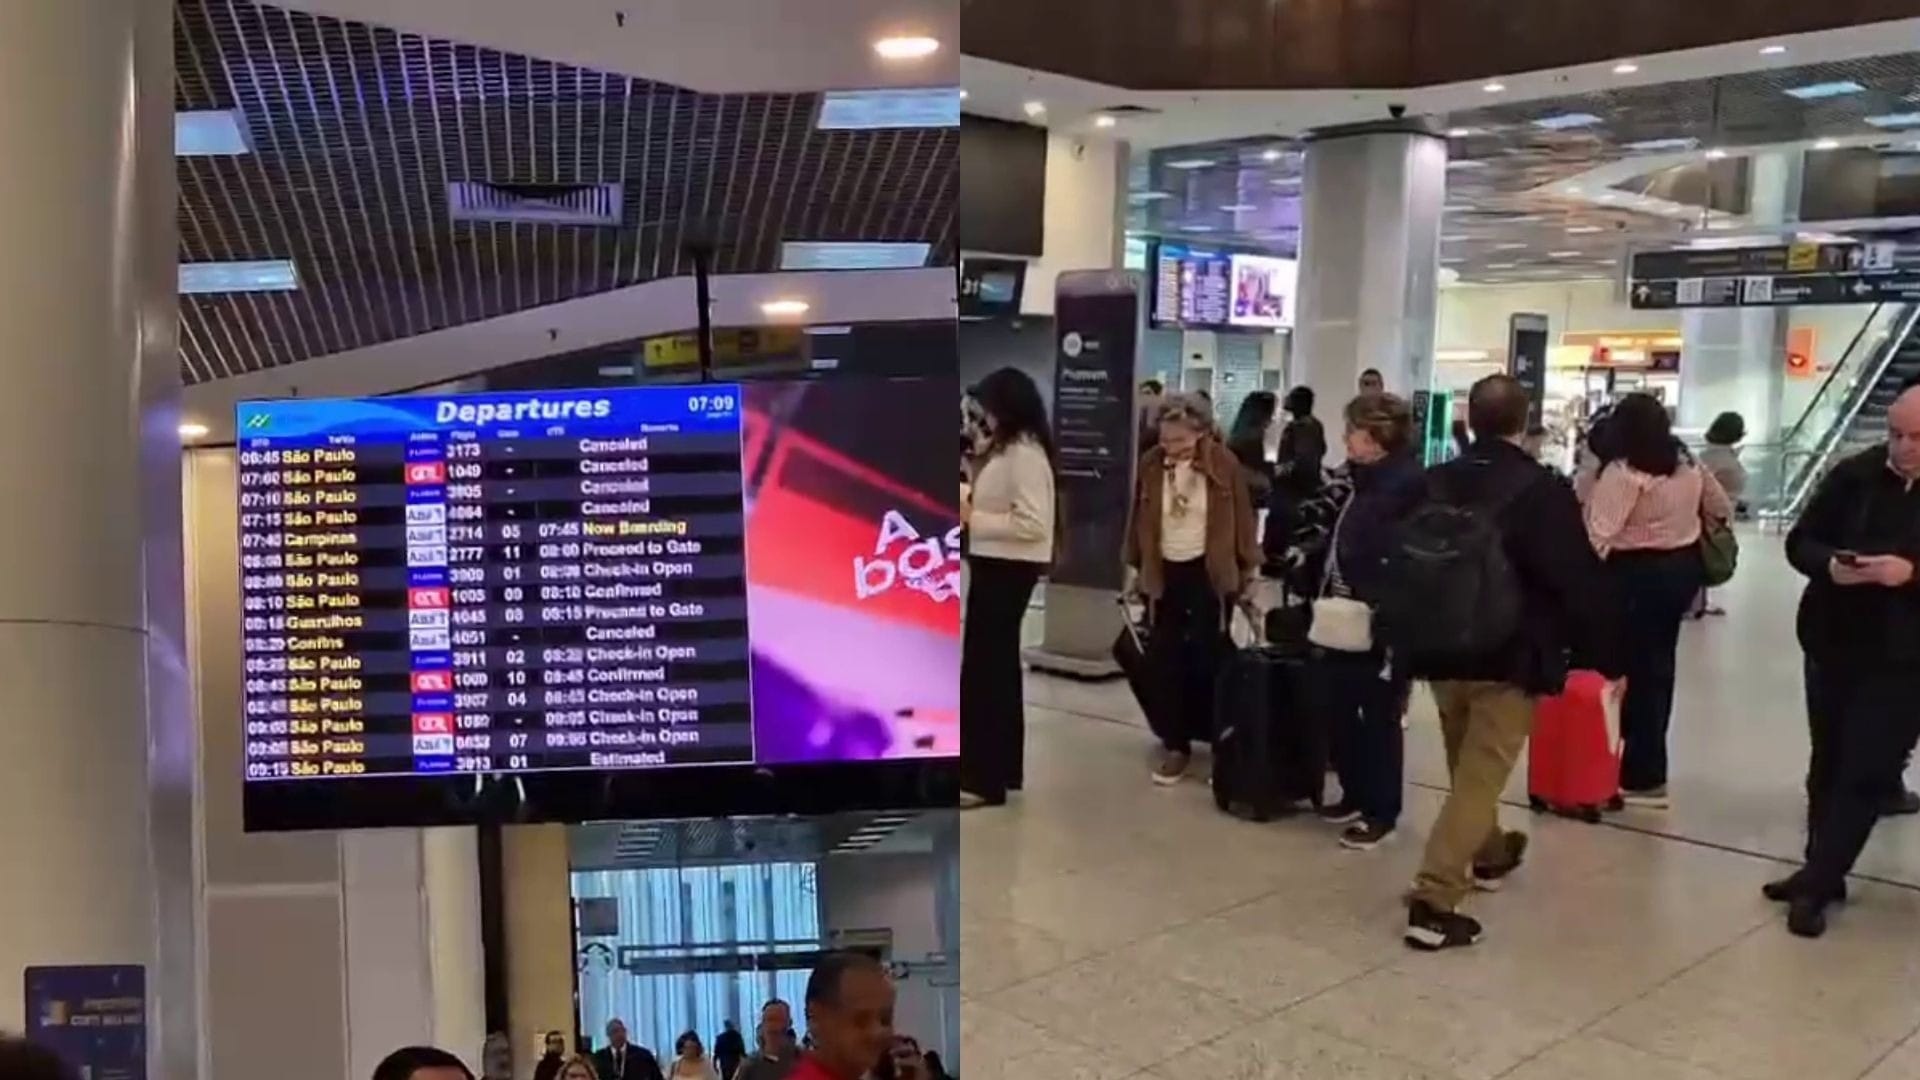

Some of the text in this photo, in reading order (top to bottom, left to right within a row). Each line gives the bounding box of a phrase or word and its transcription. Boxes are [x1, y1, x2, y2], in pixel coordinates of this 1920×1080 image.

[436, 398, 611, 426] Departures
[688, 395, 735, 412] 07:09
[314, 449, 356, 463] Paulo
[314, 469, 356, 483] Paulo
[580, 457, 648, 474] Canceled
[315, 489, 357, 504] Paulo
[315, 510, 357, 525] Paulo
[285, 532, 357, 547] Campinas
[583, 522, 615, 535] Now
[619, 520, 686, 536] Boarding
[874, 510, 920, 555] A
[317, 551, 359, 566] Paulo
[503, 545, 521, 559] 11
[584, 542, 644, 557] Proceed
[648, 541, 662, 554] to
[666, 540, 701, 554] Gate
[317, 572, 359, 586] Paulo
[584, 563, 648, 577] Check-in
[653, 562, 693, 577] Open
[318, 593, 360, 608] Paulo
[585, 583, 662, 599] Confirmed
[286, 614, 363, 629] Guarulhos
[650, 604, 665, 617] to
[669, 603, 703, 617] Gate
[287, 636, 344, 650] Confins
[586, 625, 655, 640] Canceled
[320, 656, 362, 670] Paulo
[587, 646, 652, 661] Check-in
[656, 645, 696, 660] Open
[320, 676, 362, 691] Paulo
[507, 671, 526, 685] 10
[588, 667, 665, 683] Confirmed
[321, 697, 363, 712] Paulo
[588, 688, 653, 703] Check-in
[657, 687, 698, 703] Open
[321, 718, 364, 733] Paulo
[658, 709, 699, 724] Open
[322, 740, 364, 754] Paulo
[509, 733, 528, 748] 07
[590, 730, 656, 745] Check-in
[659, 729, 699, 744] Open
[323, 760, 365, 774] Paulo
[590, 752, 665, 766] Estimated
